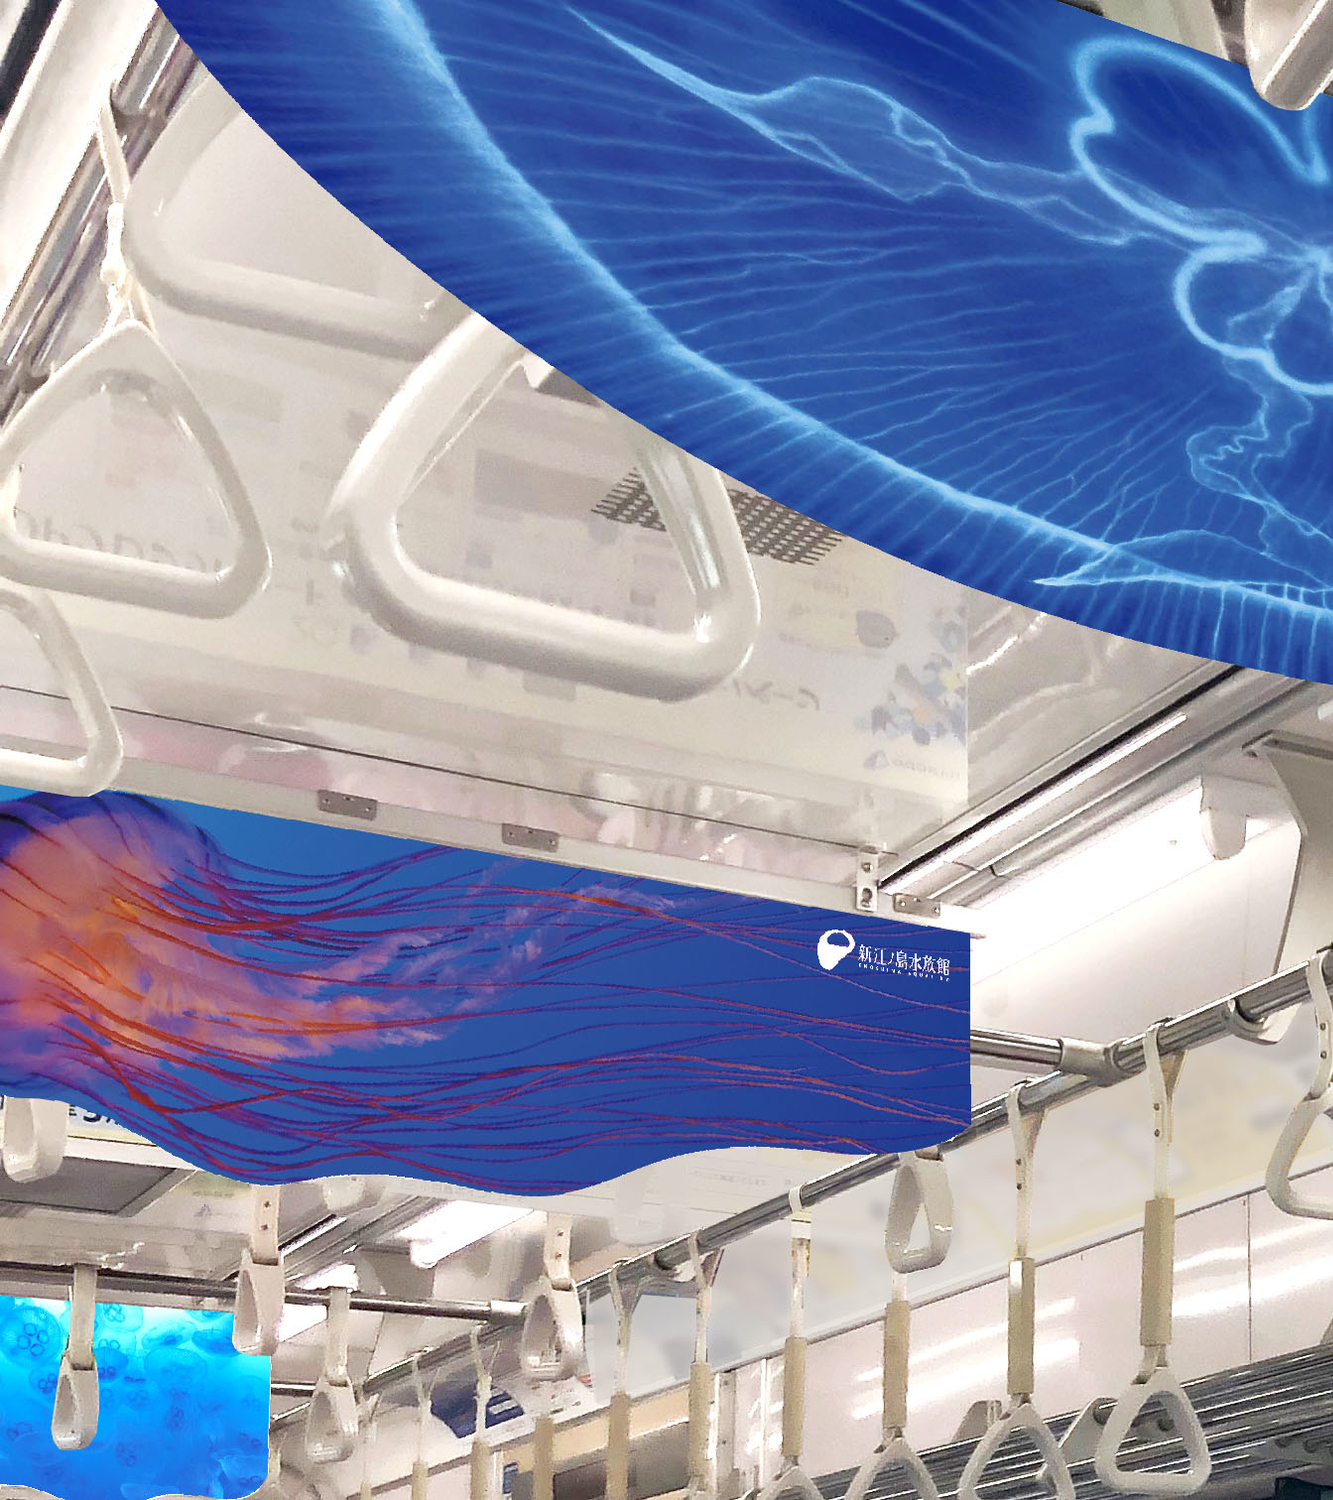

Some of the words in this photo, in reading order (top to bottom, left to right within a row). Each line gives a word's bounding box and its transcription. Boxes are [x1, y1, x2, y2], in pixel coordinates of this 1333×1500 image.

[858, 943, 950, 976] 新江ノ島水族館
